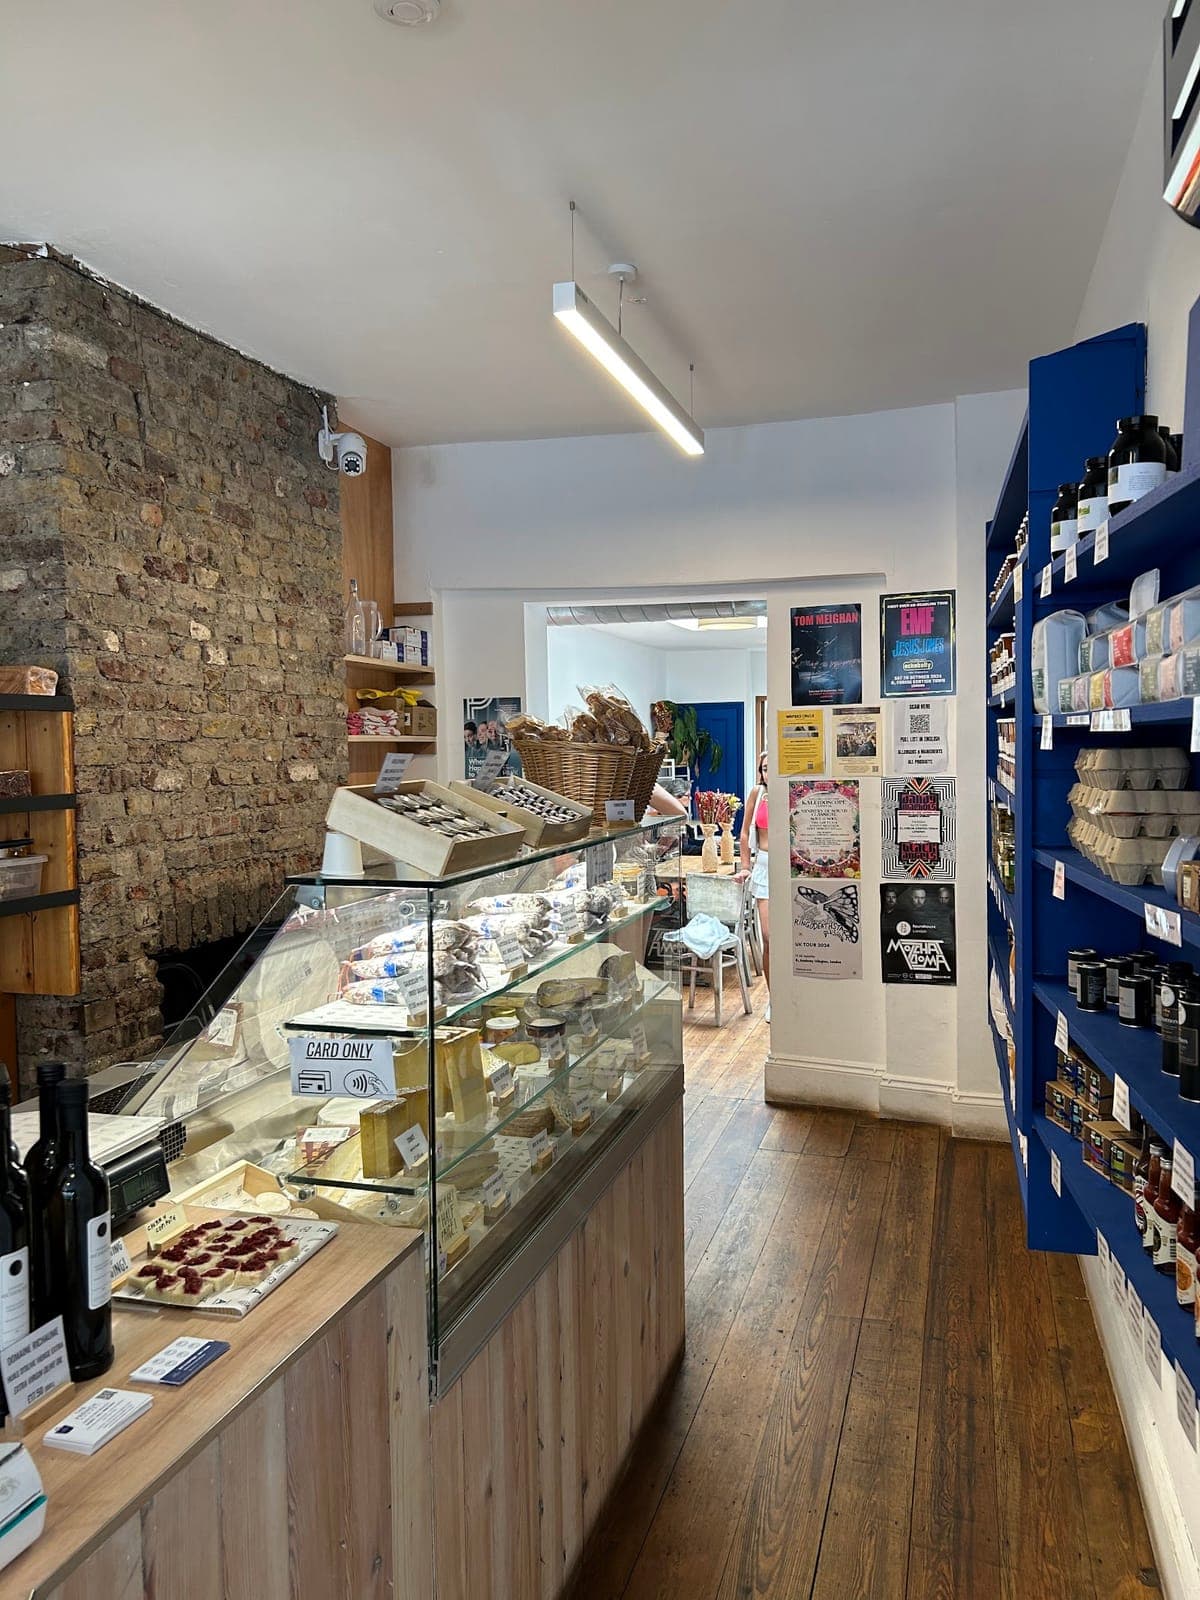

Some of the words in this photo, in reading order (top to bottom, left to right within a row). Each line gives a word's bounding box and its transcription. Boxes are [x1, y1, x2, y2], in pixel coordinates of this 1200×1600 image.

[794, 614, 814, 626] TOM
[816, 612, 858, 625] MEIGHAN
[900, 606, 934, 636] EMF
[892, 639, 920, 657] JESUS
[920, 638, 945, 654] JONES
[306, 1041, 339, 1058] CARD
[342, 1042, 374, 1058] ONLY
